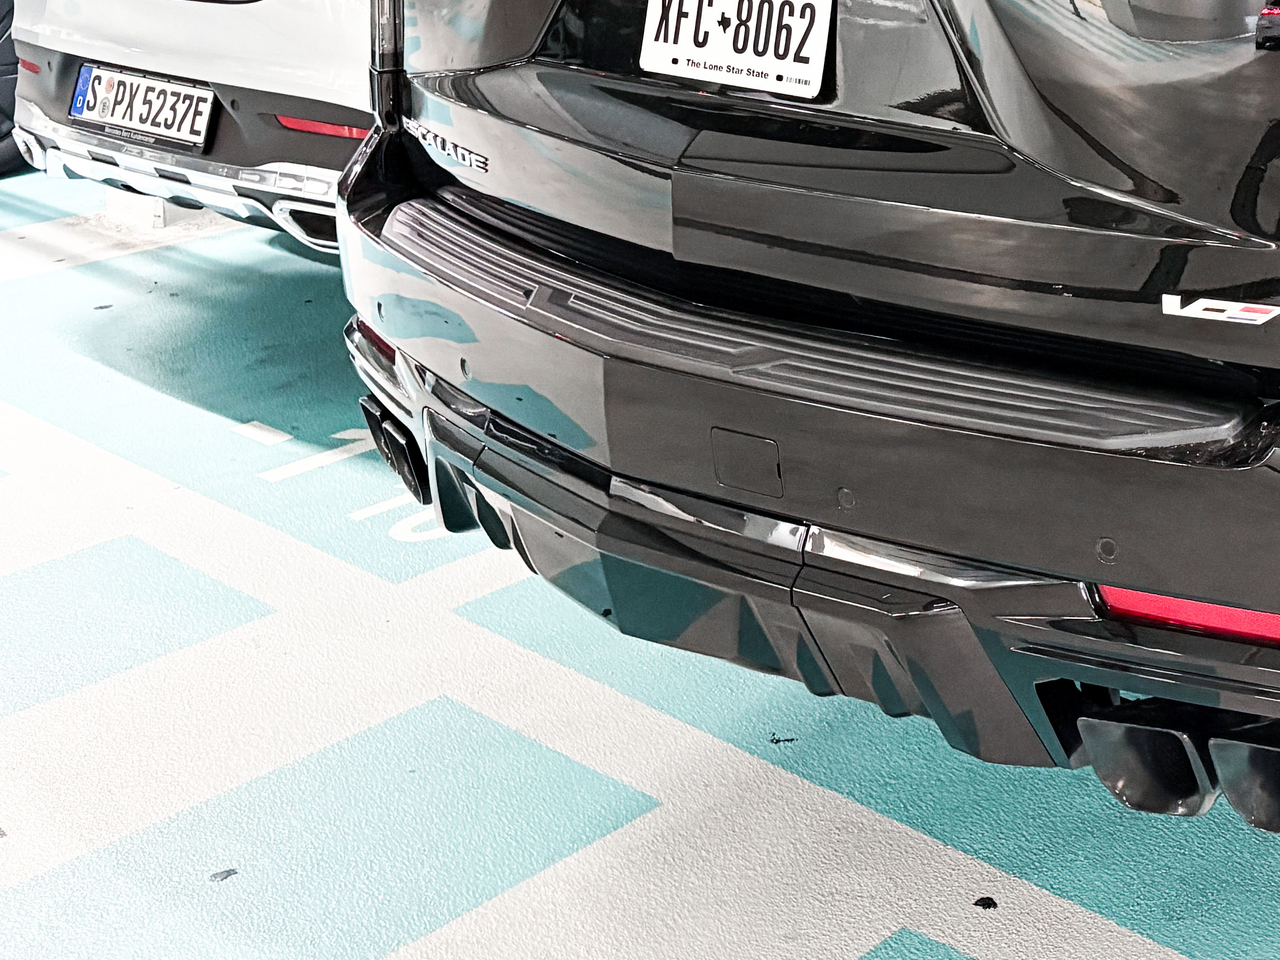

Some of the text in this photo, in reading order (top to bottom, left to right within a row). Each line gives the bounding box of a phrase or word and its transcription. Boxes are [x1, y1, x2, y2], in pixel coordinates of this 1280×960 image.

[686, 58, 769, 79] The Lone Star State
[76, 96, 84, 108] D
[86, 74, 208, 137] S PX 5237E
[402, 114, 490, 174] ESCALADE
